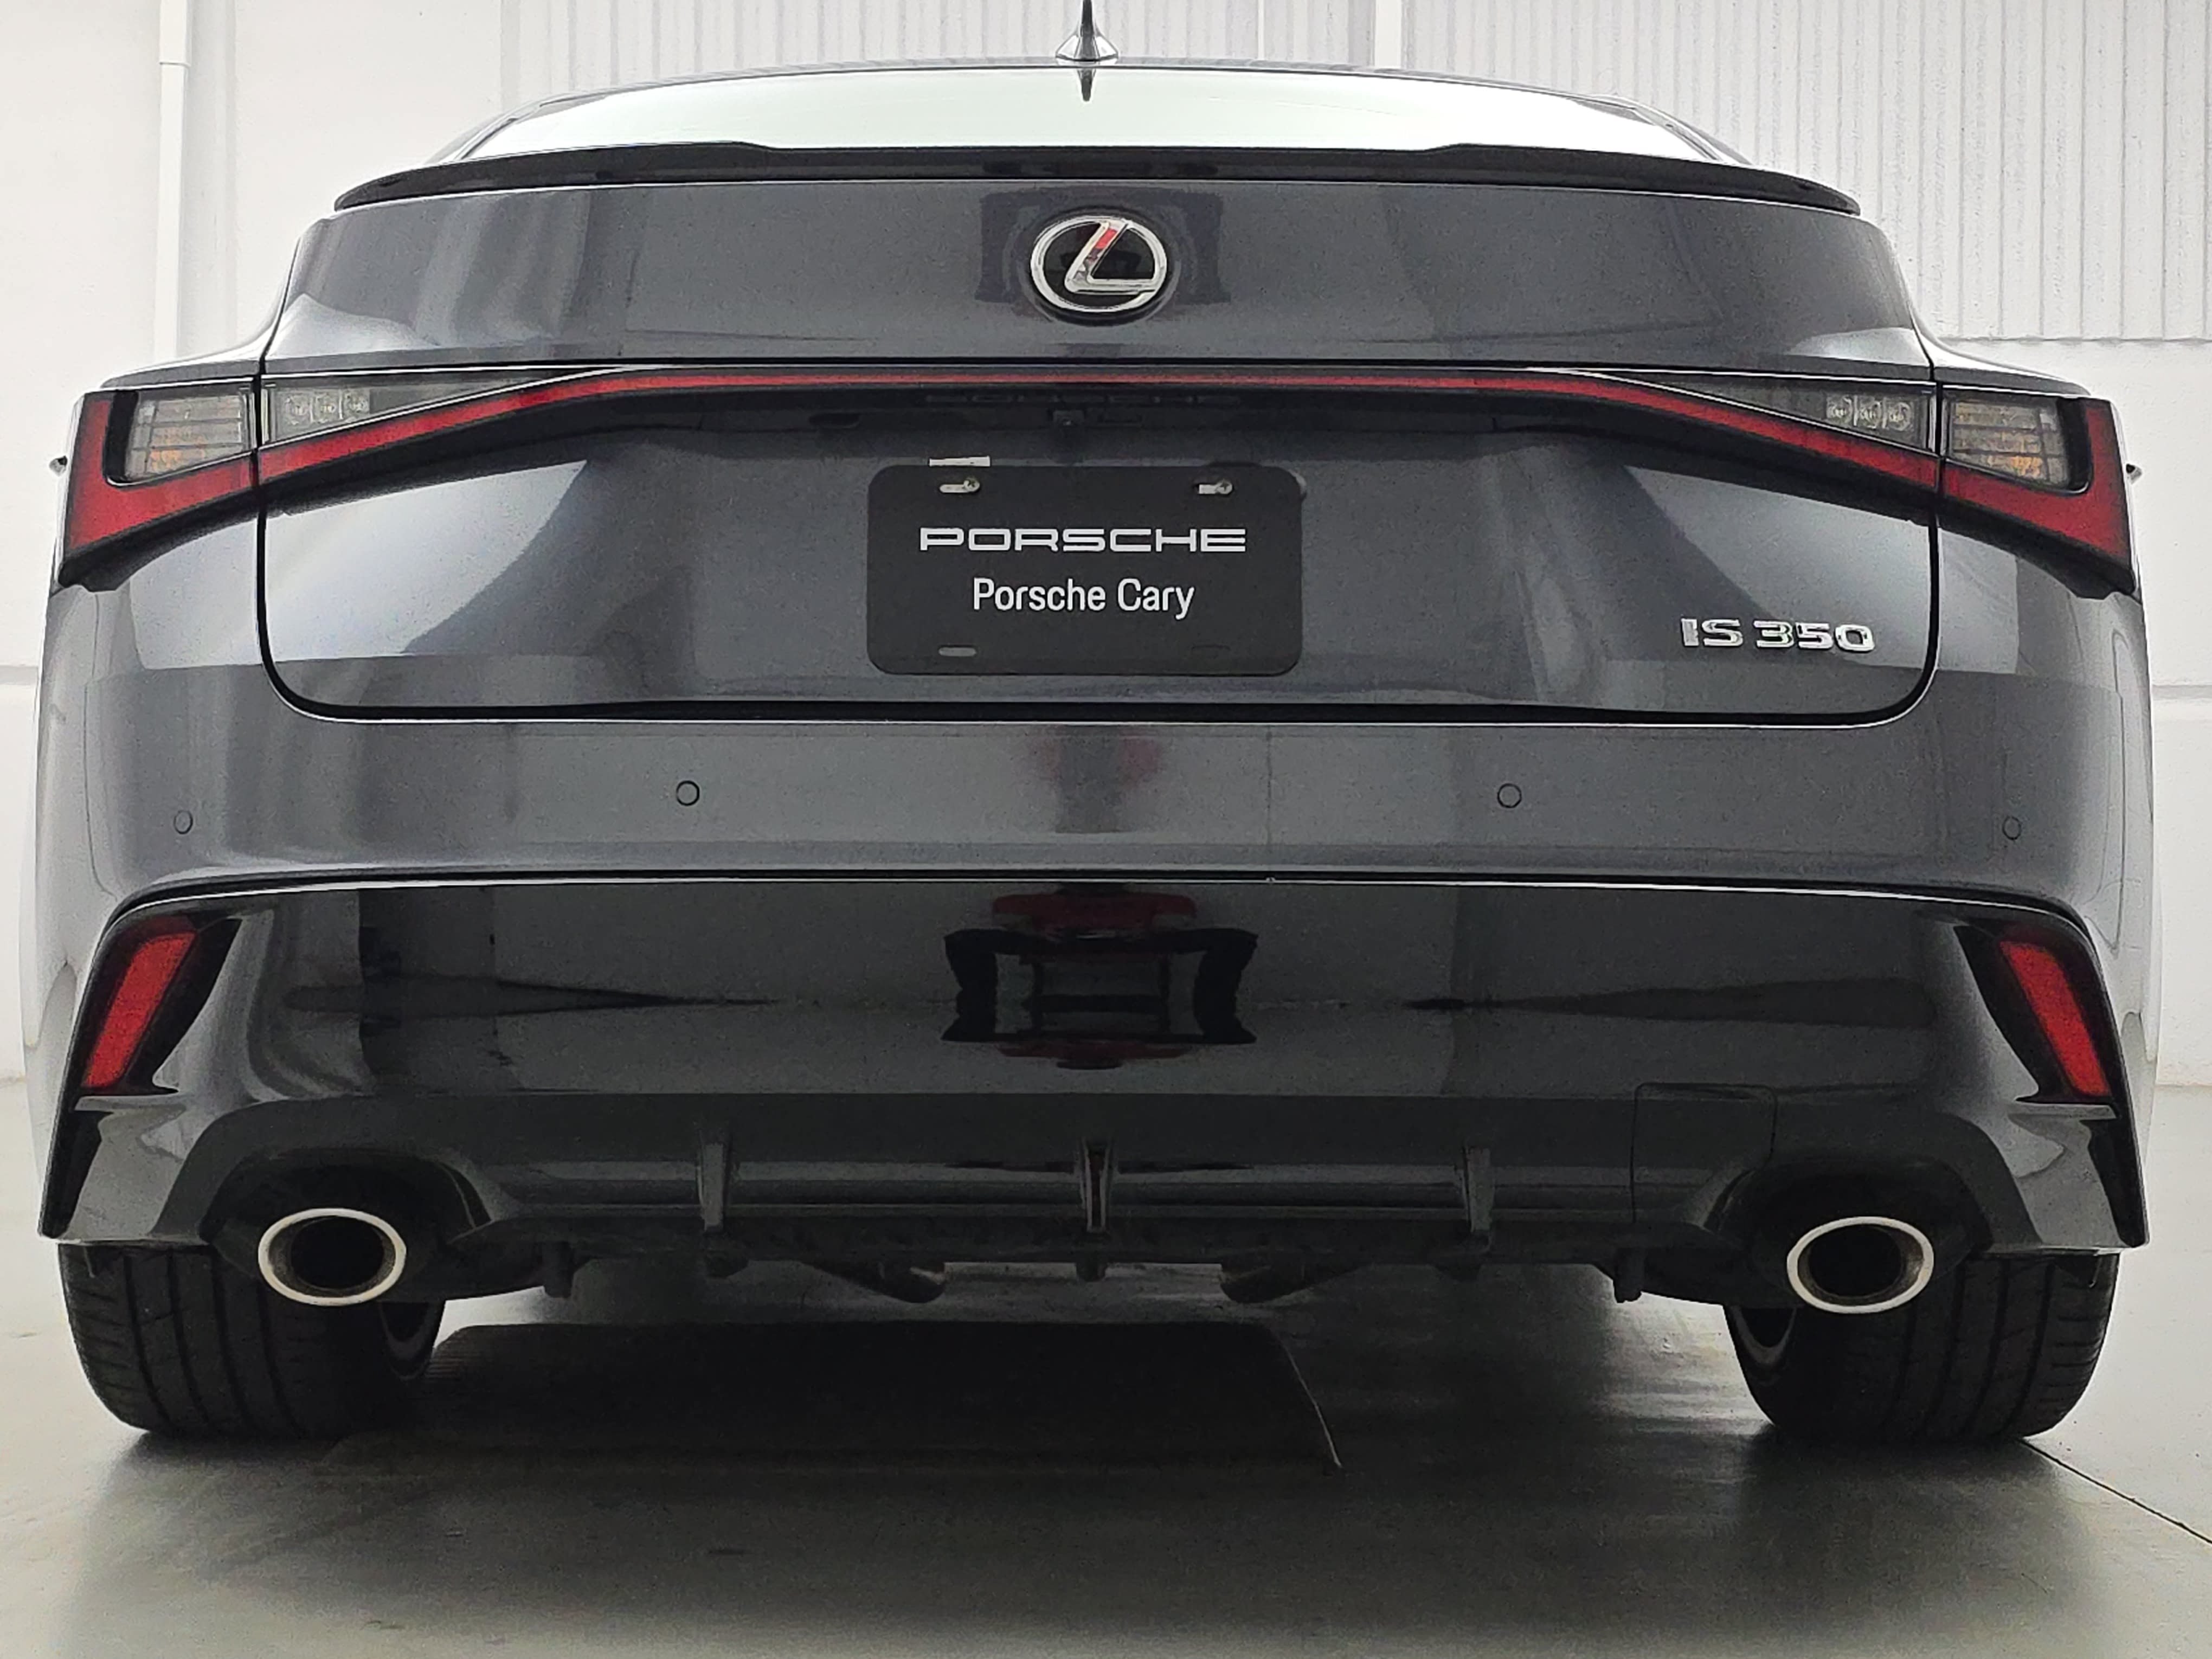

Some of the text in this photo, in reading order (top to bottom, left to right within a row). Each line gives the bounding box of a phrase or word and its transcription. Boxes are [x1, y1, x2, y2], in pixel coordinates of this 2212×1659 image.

[919, 528, 1247, 552] PORSCHE
[973, 577, 1195, 620] Porsche Cary
[1680, 618, 1875, 652] IS 350
